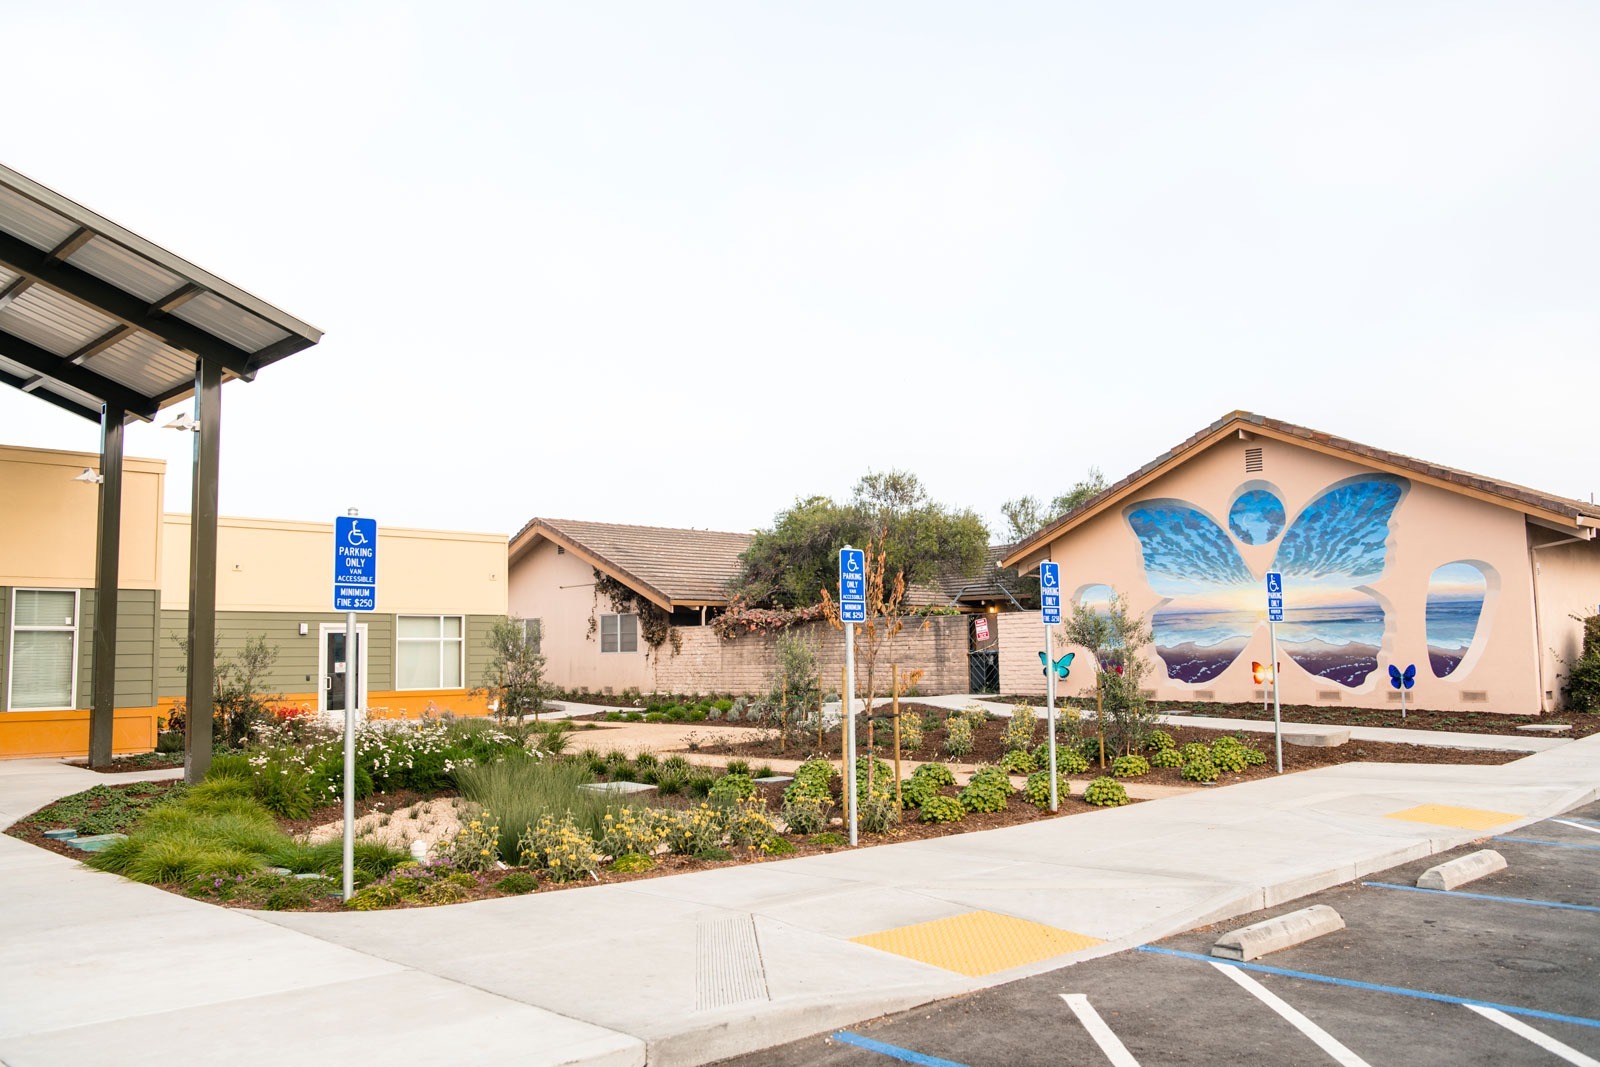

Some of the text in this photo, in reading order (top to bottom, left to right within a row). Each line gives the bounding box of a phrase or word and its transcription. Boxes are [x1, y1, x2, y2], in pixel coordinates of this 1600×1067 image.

[339, 547, 373, 557] PARKING
[346, 558, 366, 567] ONLY
[843, 572, 862, 580] PARKING
[340, 588, 370, 596] MINIMUM
[1042, 586, 1059, 596] PARKING
[337, 598, 372, 607] FINE $250
[1046, 596, 1056, 605] ONLY
